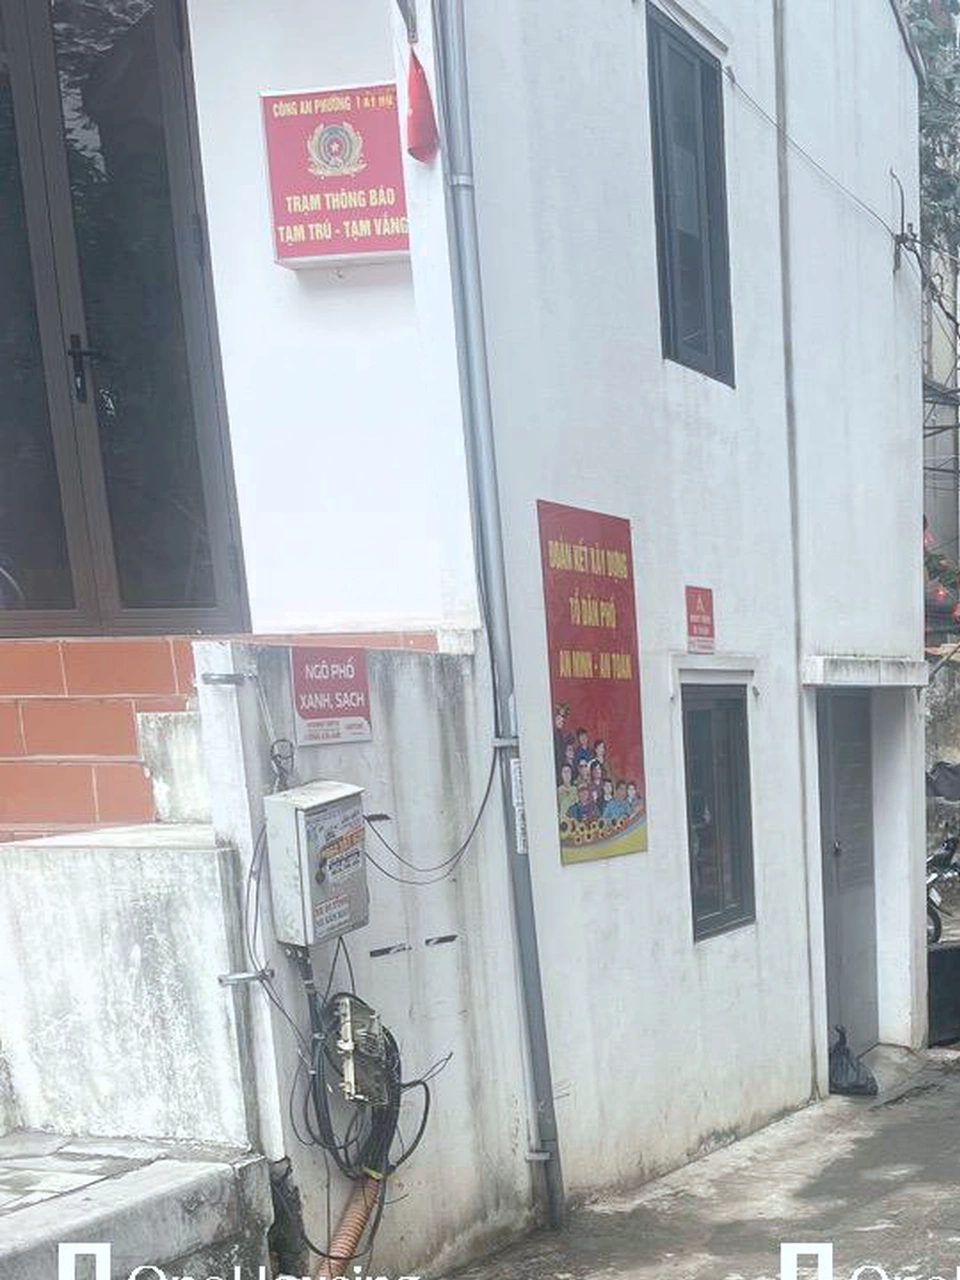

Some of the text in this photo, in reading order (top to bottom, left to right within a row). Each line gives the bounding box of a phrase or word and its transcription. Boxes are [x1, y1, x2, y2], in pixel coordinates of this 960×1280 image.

[299, 101, 313, 116] AN
[286, 185, 395, 216] TRẠM THÔNG BÁO
[278, 225, 306, 246] TẠM
[308, 216, 331, 241] TRÚ
[343, 219, 371, 242] TẠM
[581, 594, 600, 627] DÂN
[330, 656, 355, 679] PHỐ
[335, 692, 364, 710] SẠCH
